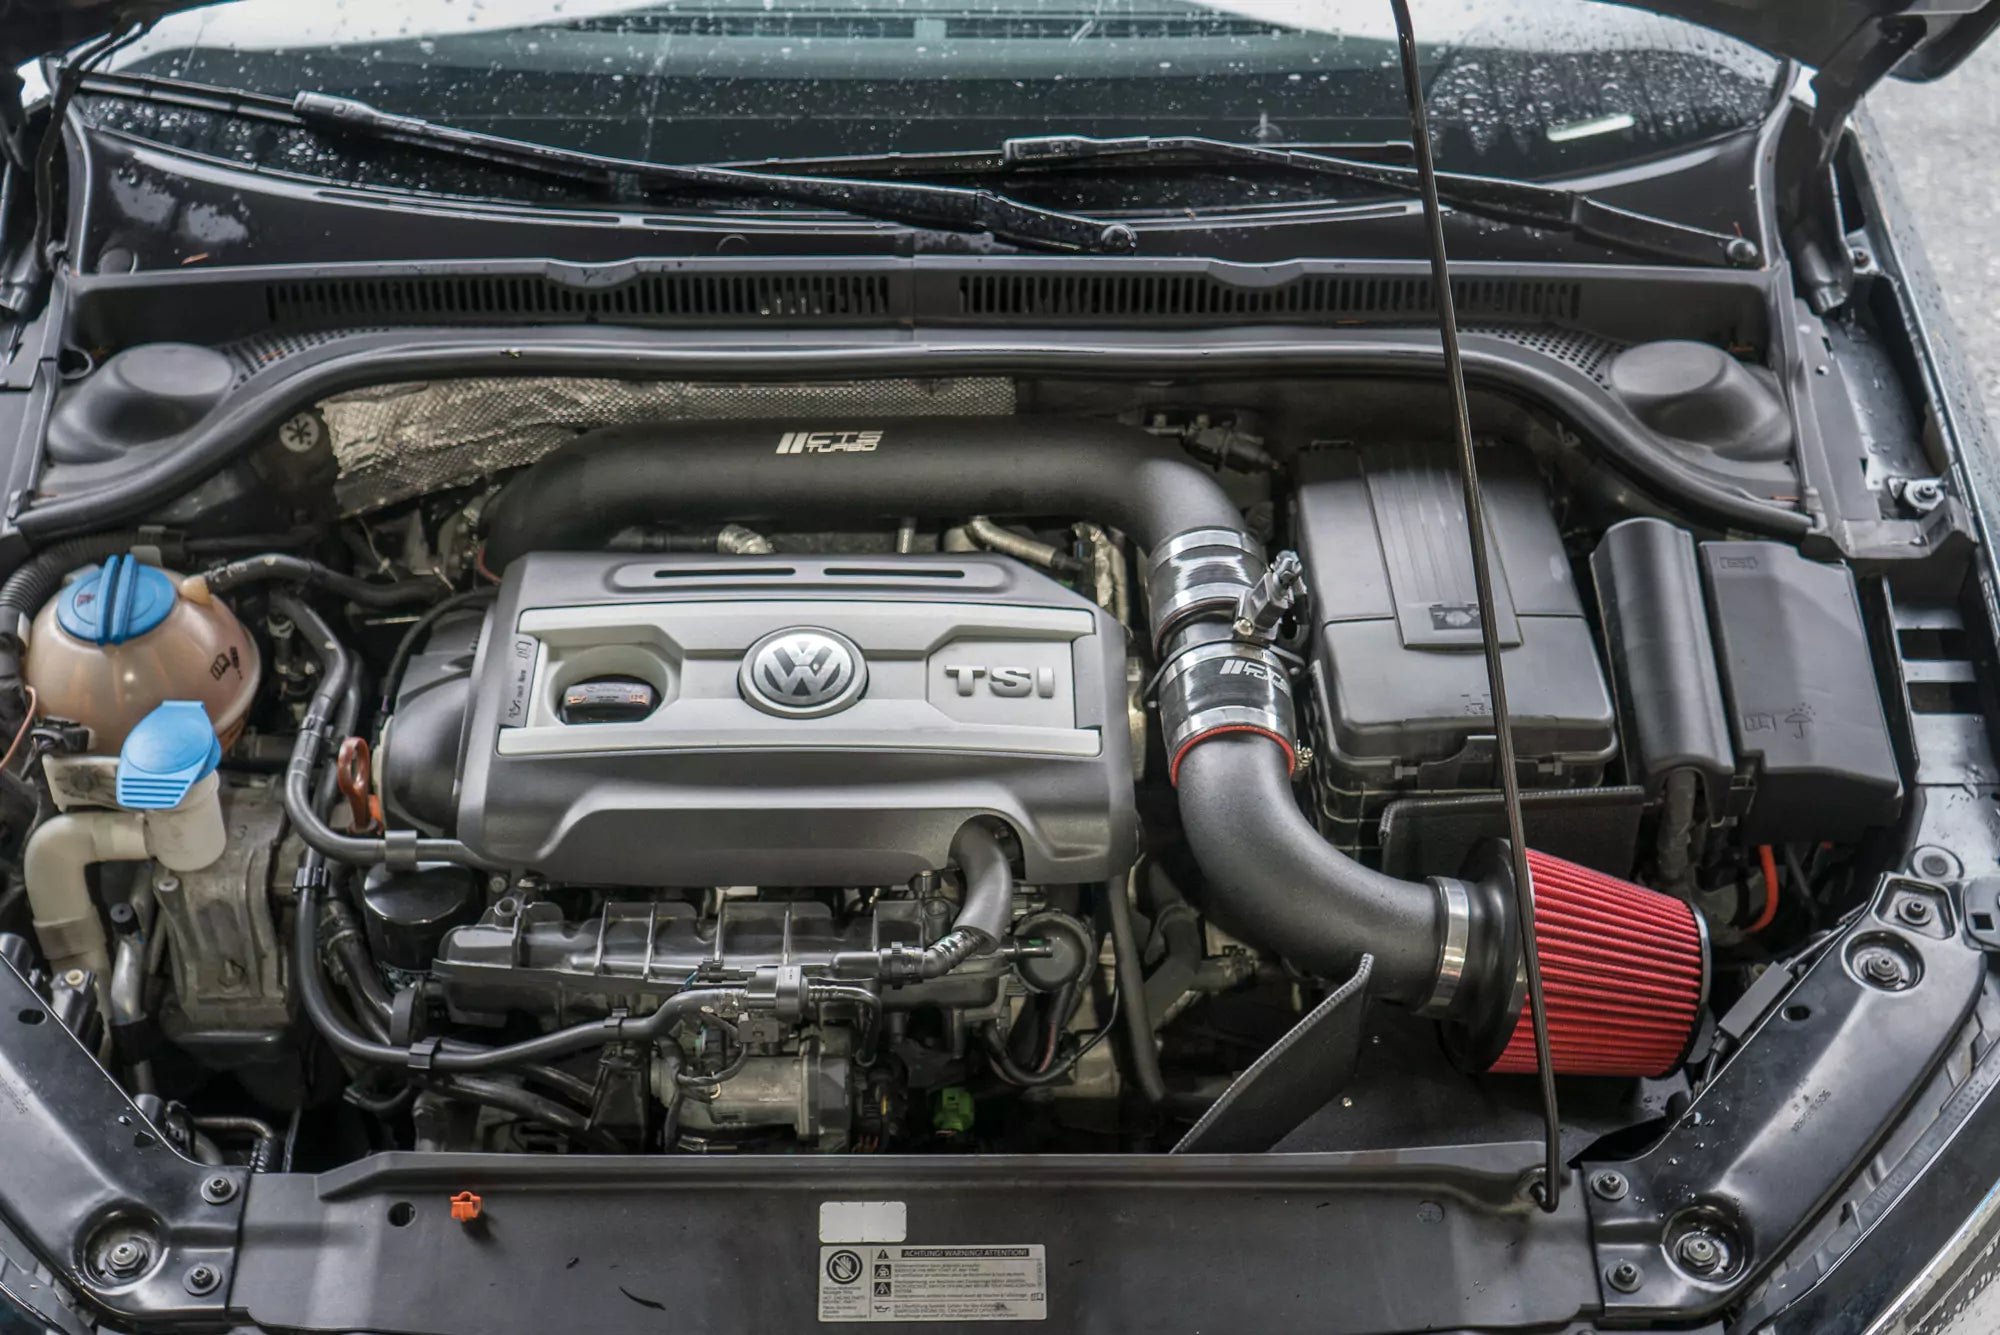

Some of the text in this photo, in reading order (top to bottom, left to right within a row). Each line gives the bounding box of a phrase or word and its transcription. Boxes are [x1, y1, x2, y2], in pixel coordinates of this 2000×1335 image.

[805, 442, 878, 453] TURBO
[944, 664, 1055, 699] TSI
[944, 1249, 983, 1257] WARNING!
[984, 1248, 1028, 1256] ATTENTION!
